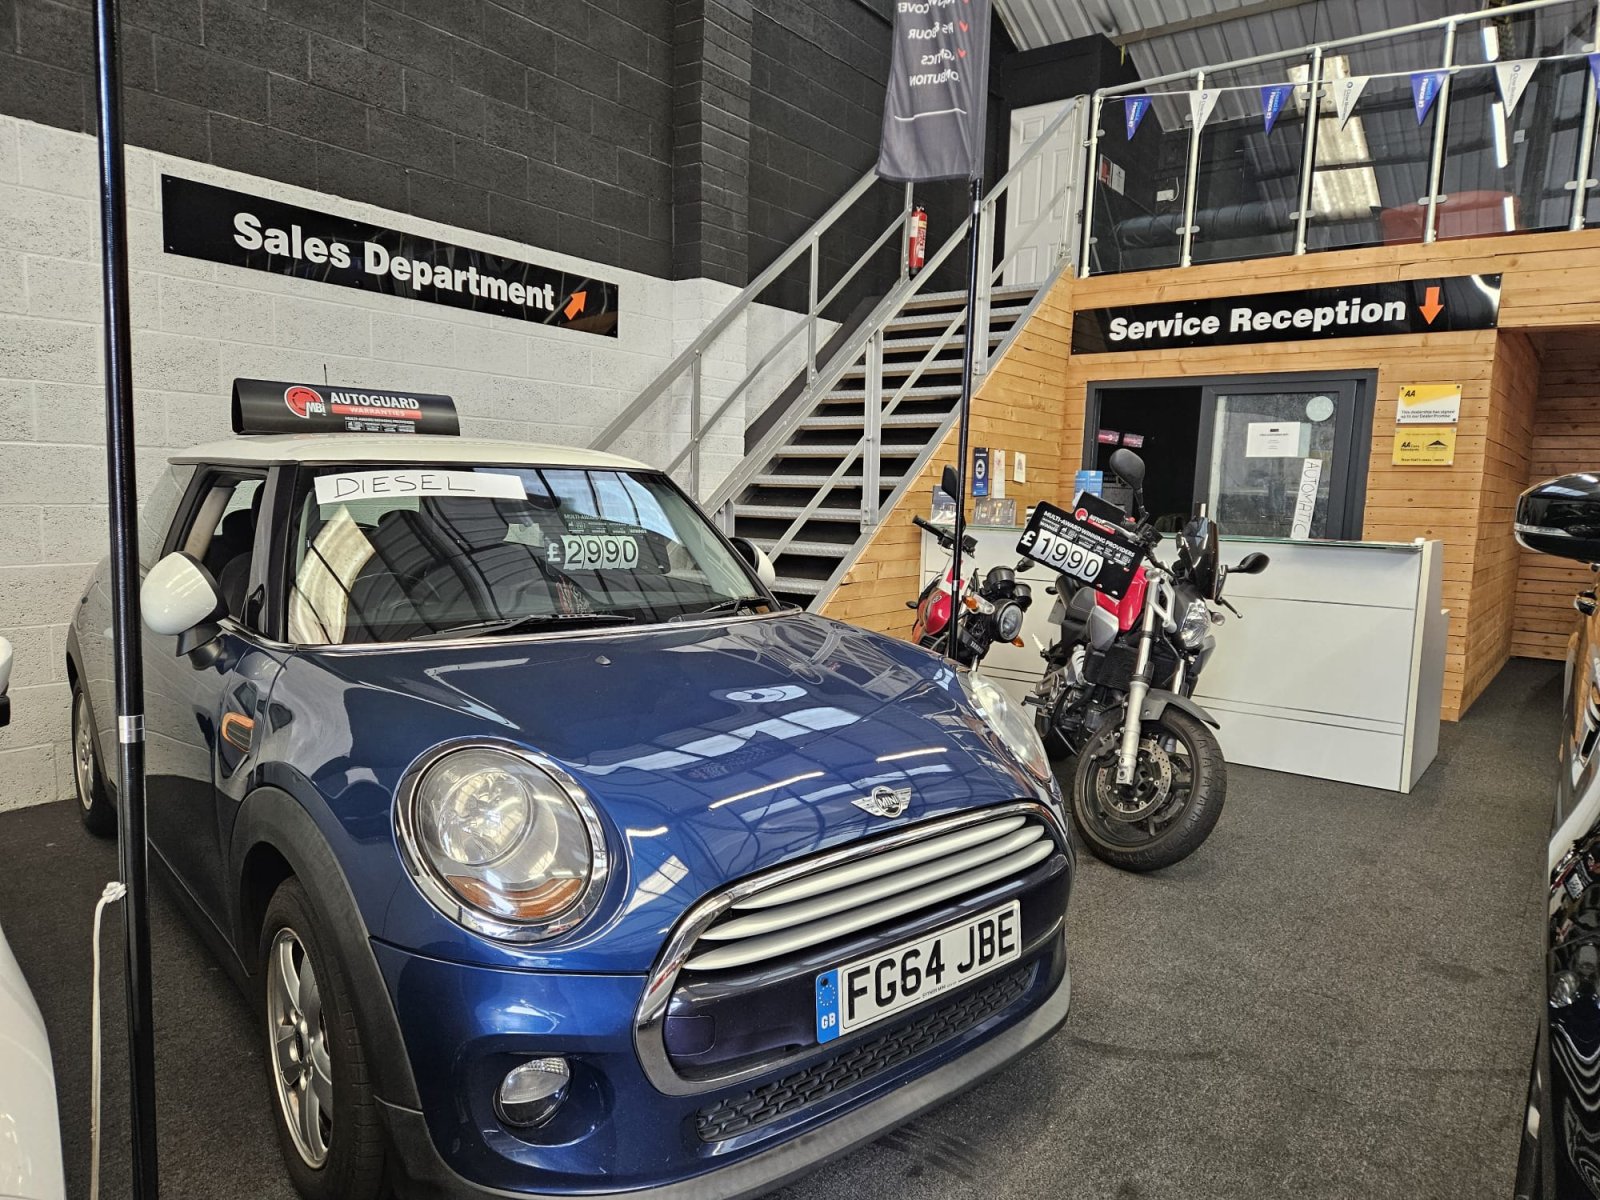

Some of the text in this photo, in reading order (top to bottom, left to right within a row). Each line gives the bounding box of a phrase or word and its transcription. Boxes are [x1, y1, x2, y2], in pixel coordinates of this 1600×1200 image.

[233, 212, 555, 312] Sales Department
[1109, 297, 1407, 341] Service Reception
[330, 392, 420, 410] AUTOGUARD
[349, 406, 405, 417] WARRANTIES
[334, 474, 475, 498] DIESEL
[1294, 461, 1319, 533] AUTOMATIC
[1043, 510, 1082, 532] MULTI-AWARD
[1081, 527, 1106, 544] WINNING
[1105, 538, 1136, 557] PROVIDERS
[877, 794, 898, 809] MINI
[847, 909, 1015, 1021] FG64 JBE
[821, 1012, 836, 1030] GB
